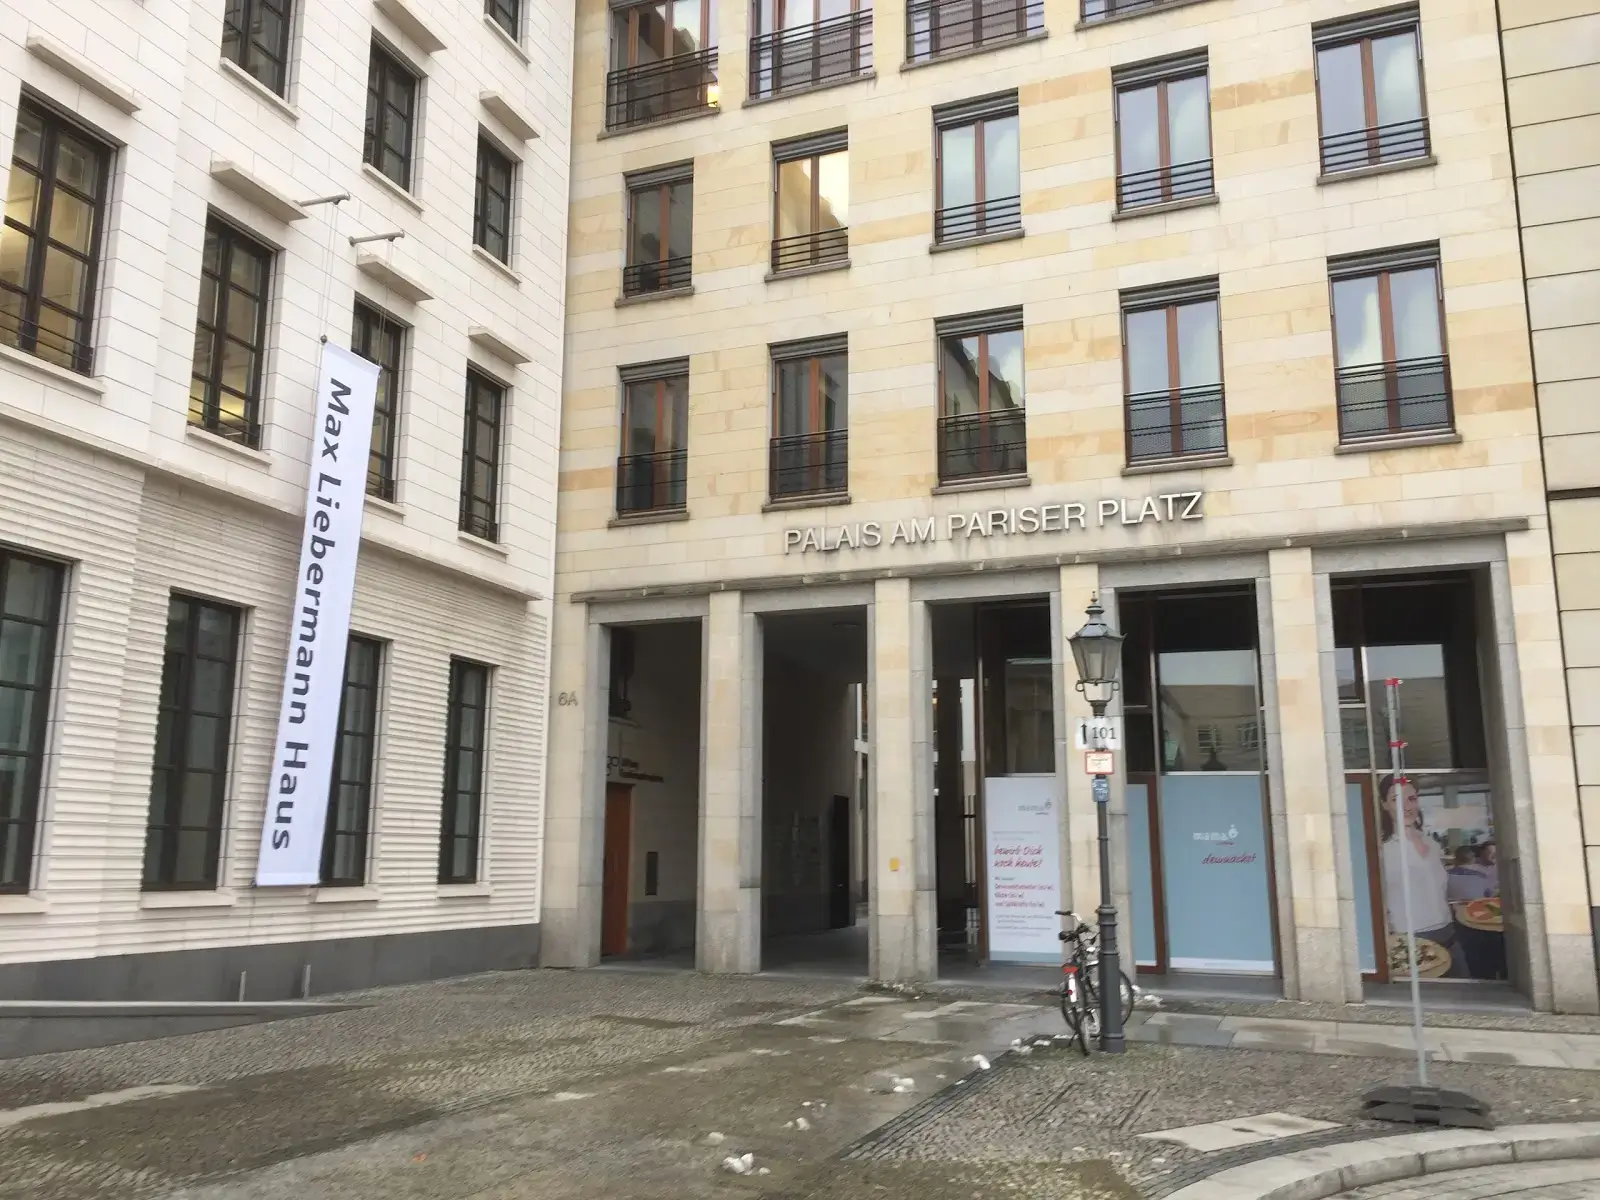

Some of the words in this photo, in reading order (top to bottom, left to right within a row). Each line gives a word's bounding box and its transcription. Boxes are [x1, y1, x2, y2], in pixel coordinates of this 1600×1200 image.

[321, 377, 352, 462] Max
[784, 521, 882, 554] PALAIS
[889, 516, 936, 545] AM
[947, 502, 1087, 540] PARISER
[1098, 491, 1204, 527] PLATZ
[288, 472, 342, 724] Liebermann
[1091, 726, 1117, 740] 101
[271, 741, 309, 850] Haus
